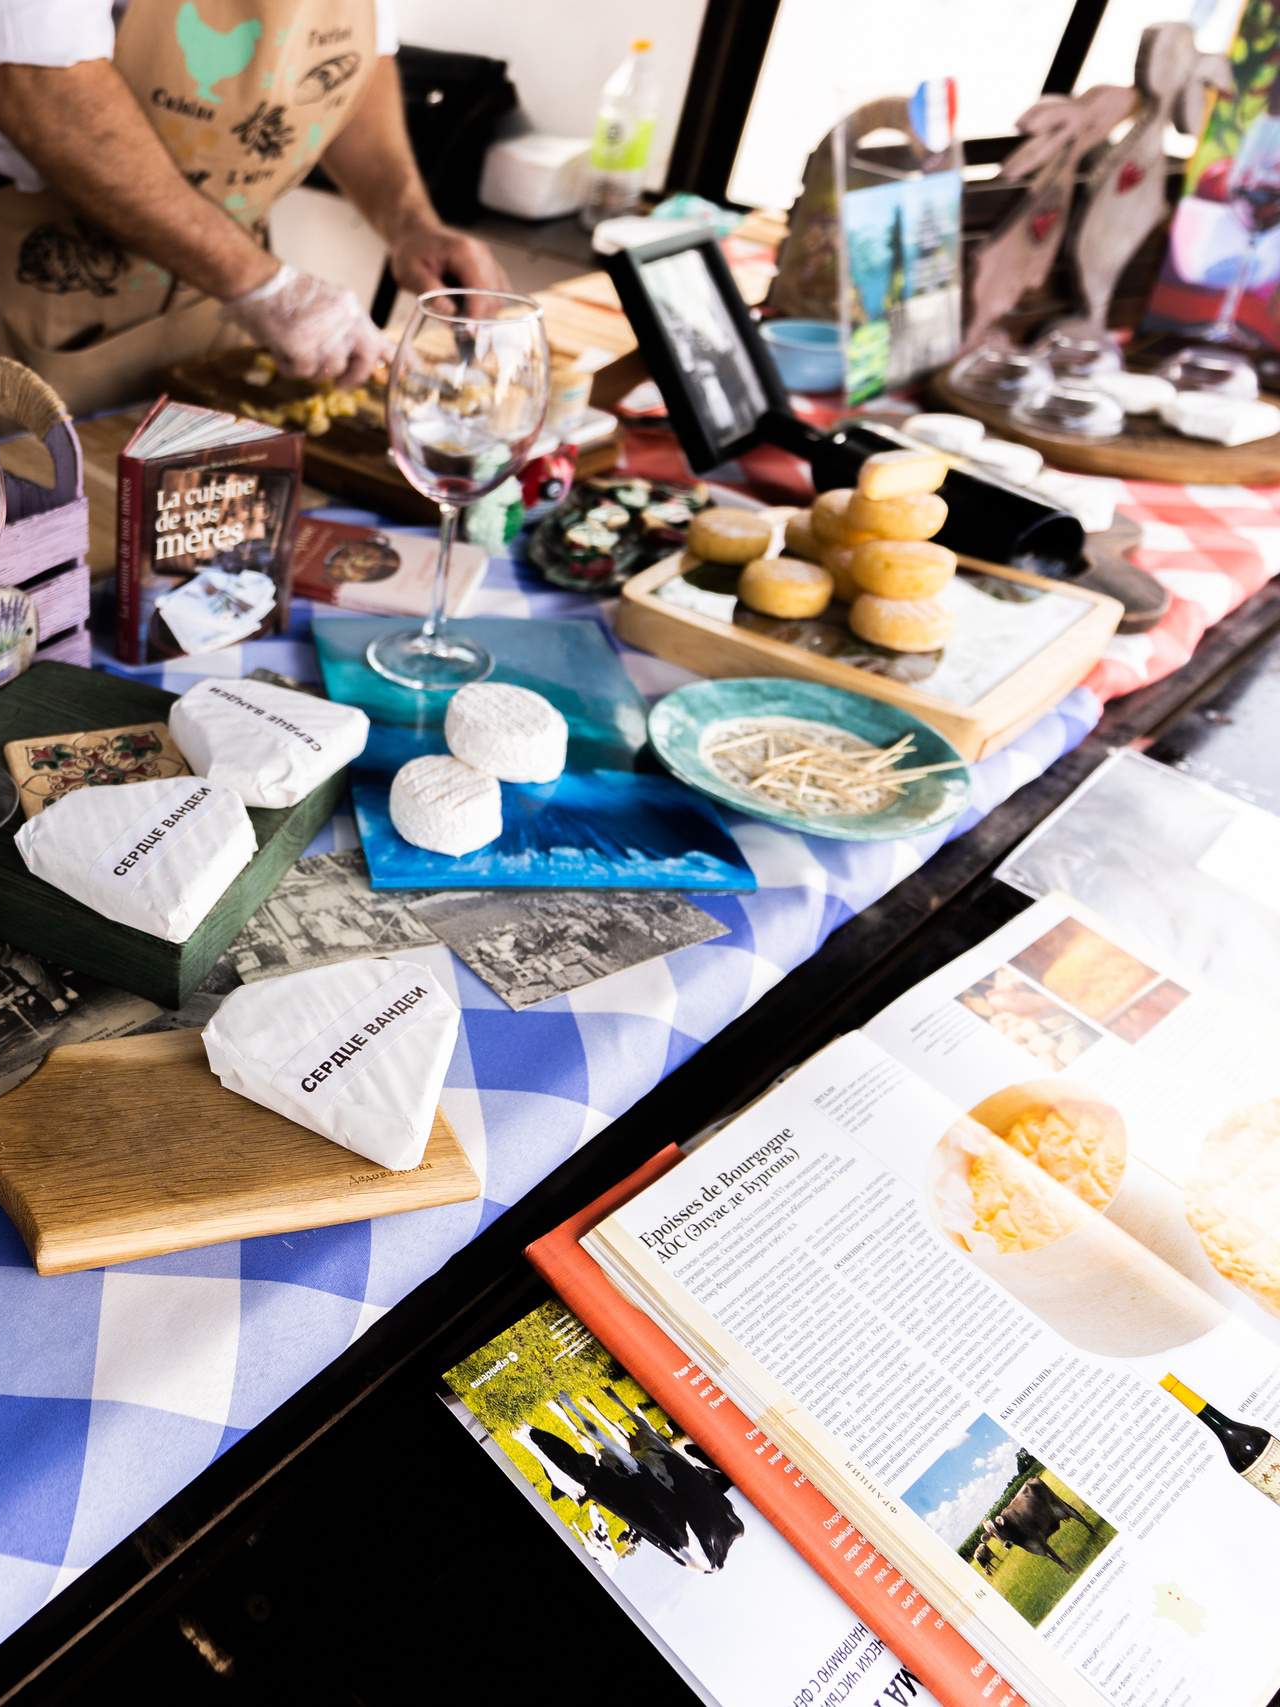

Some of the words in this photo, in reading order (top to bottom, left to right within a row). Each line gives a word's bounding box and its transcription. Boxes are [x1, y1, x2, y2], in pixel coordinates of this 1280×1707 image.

[151, 87, 216, 122] Cuisine
[157, 490, 181, 512] La
[185, 479, 255, 505] cuisine
[155, 511, 181, 532] de
[185, 506, 221, 527] nos
[155, 522, 244, 560] mères
[208, 687, 265, 716] ВАНДЕИ
[265, 714, 322, 752] СЕРДЦЕ
[113, 827, 166, 877] СЕРДЦЕ
[162, 787, 212, 829] ВАНДЕИ
[301, 1034, 368, 1093] СЕРДЦЕ
[363, 985, 429, 1037] ВАНДЕИ
[638, 1199, 703, 1248] Epoisses
[700, 1185, 722, 1202] de
[716, 1128, 793, 1188] Bourgogne
[684, 1204, 729, 1241] (Эпуас
[728, 1192, 745, 1209] де
[740, 1147, 799, 1195] Бургонь)
[833, 1233, 875, 1270] ОСОБЕННОСТИ
[470, 1358, 509, 1388] organicferma
[672, 1365, 690, 1380] Ради
[689, 1372, 707, 1386] прод
[698, 1385, 714, 1398] ноги
[999, 1405, 1015, 1420] КАК
[1011, 1368, 1052, 1408] УПОТРЕБЛЯТЬ
[754, 1444, 765, 1455] вы
[793, 1480, 800, 1488] и
[845, 1461, 897, 1513] ФРАНЦИЯ
[822, 1512, 842, 1530] Откро
[843, 1543, 863, 1562] сидра,
[853, 1552, 877, 1577] который
[873, 1567, 890, 1584] лука,
[900, 1595, 914, 1609] сыр
[910, 1604, 931, 1628] жители
[817, 1622, 870, 1684] НАПРЯМУЮ
[970, 1659, 987, 1677] боле
[980, 1673, 1002, 1699] мастер
